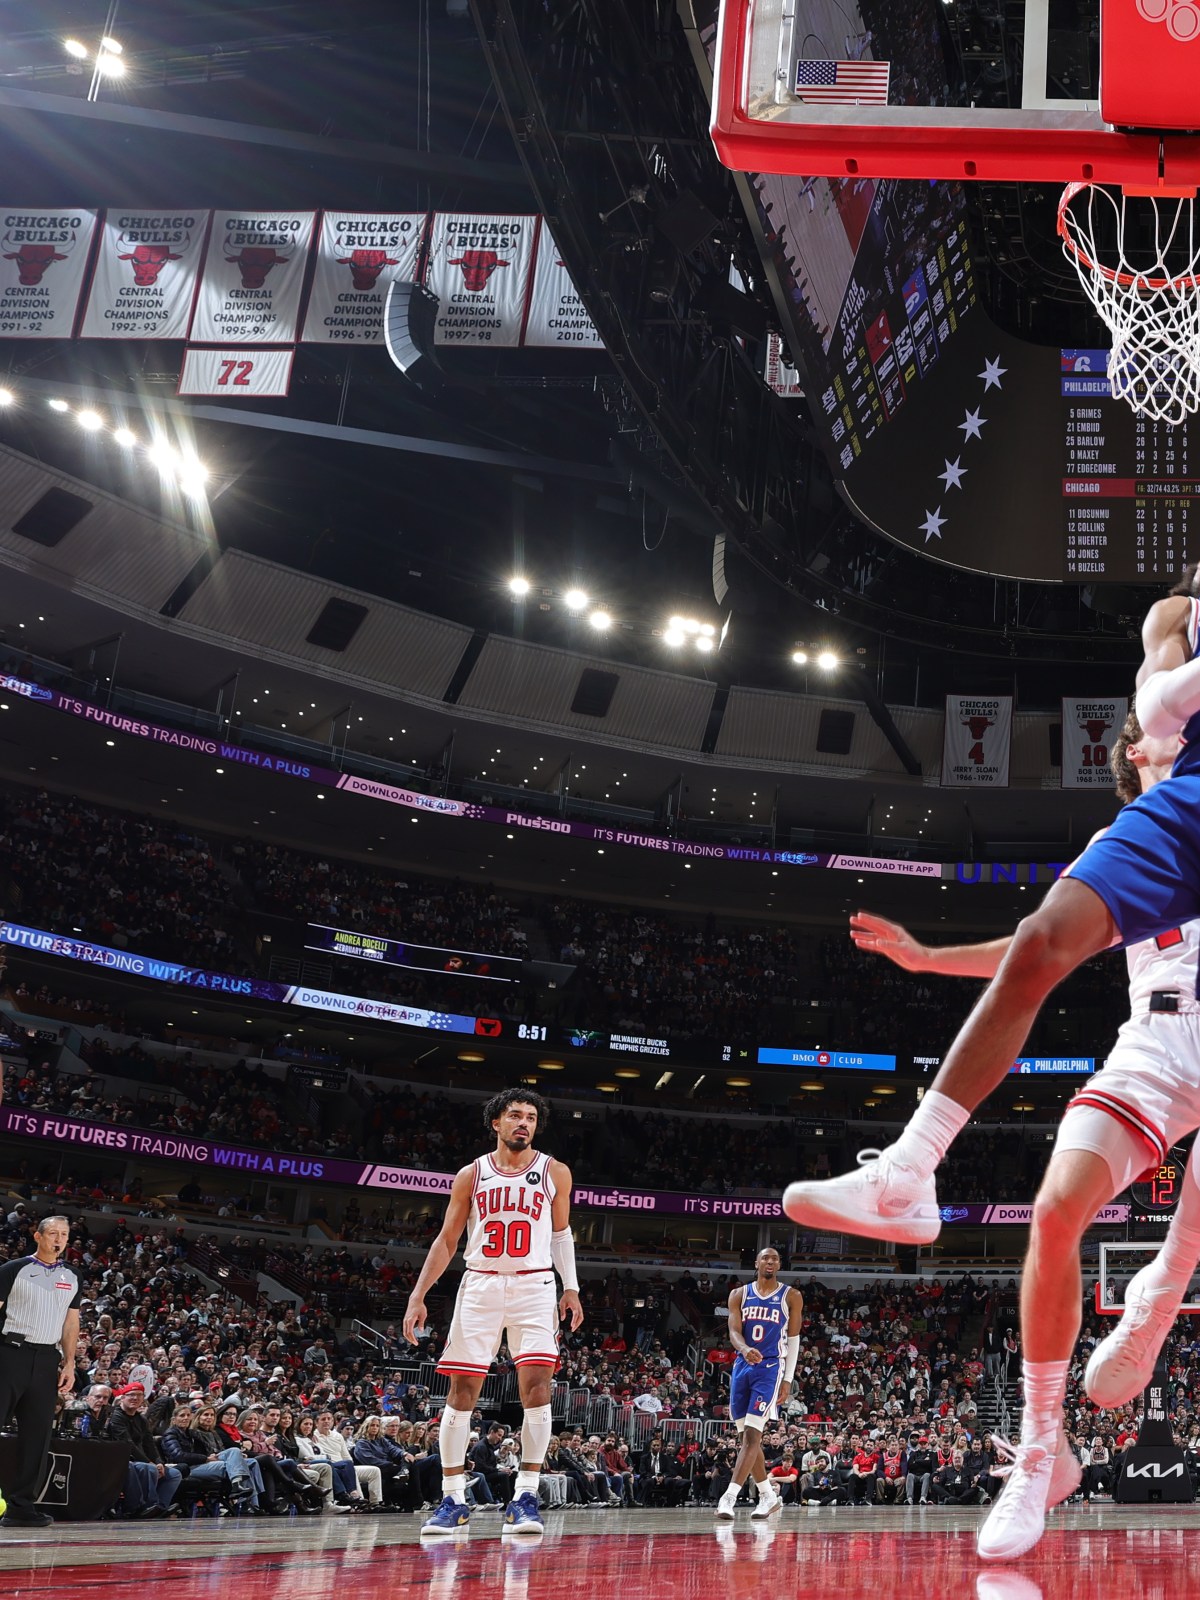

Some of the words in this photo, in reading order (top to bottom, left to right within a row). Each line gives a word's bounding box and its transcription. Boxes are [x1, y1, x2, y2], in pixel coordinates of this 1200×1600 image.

[4, 216, 82, 228] CHICAGO
[118, 216, 194, 229] CHICAGO
[225, 219, 300, 231] CHICAGO
[447, 223, 521, 234] CHICAGO
[13, 230, 68, 242] BULLS
[128, 231, 182, 242] BULLS
[234, 234, 288, 245] BULLS
[456, 236, 510, 248] BULLS
[119, 287, 164, 296] CENTRAL
[115, 299, 163, 308] DIVISION
[452, 294, 495, 303] CENTRAL
[104, 310, 168, 319] CHAMPIONS
[448, 307, 495, 316] DIVISION
[438, 318, 501, 328] CHAMPIONS
[218, 360, 254, 386] 72
[1077, 409, 1101, 418] GRIMES
[1077, 436, 1104, 446] BARLOW
[1077, 450, 1099, 460] MAXEY
[1077, 464, 1116, 474] EDGECOMBE
[1065, 483, 1100, 493] CHICAGO
[1078, 523, 1105, 532] COLLINS
[1078, 536, 1107, 545] HUERTER
[1078, 550, 1099, 559] JONES
[1078, 563, 1105, 572] BUZELIS
[59, 697, 82, 714] IT'S
[86, 707, 149, 735] FUTURES
[152, 727, 217, 754] TRADING
[221, 745, 259, 765] WITH
[263, 758, 272, 768] A
[276, 760, 310, 777] PLUS
[968, 742, 984, 764] 4
[1082, 745, 1107, 766] 10
[353, 781, 413, 803] DOWNLOAD
[507, 813, 571, 833] Plus500
[593, 829, 614, 840] IT'S
[617, 833, 669, 850] FUTURES
[672, 842, 724, 857] TRADING
[727, 849, 759, 860] WITH
[763, 851, 770, 861] A
[840, 859, 895, 870] DOWNLOAD
[916, 865, 933, 874] APP
[335, 932, 360, 946] ANDREA
[362, 938, 387, 951] BOCELLI
[76, 944, 144, 973] TRADING
[149, 963, 192, 983] WITH
[196, 974, 207, 986] A
[211, 976, 252, 993] PLUS
[302, 992, 373, 1014] DOWNLOAD
[518, 1024, 546, 1041] 8:51
[610, 1034, 645, 1045] MILWAUKEE
[610, 1042, 638, 1052] MEMPHIS
[640, 1046, 670, 1056] GRIZZLIES
[793, 1054, 814, 1062] BMO
[839, 1056, 862, 1064] CLUB
[1035, 1060, 1088, 1070] PHILADELPHIA
[7, 1113, 36, 1133] IT'S
[42, 1121, 127, 1148] FUTURES
[131, 1135, 208, 1161] TRADING
[213, 1149, 259, 1169] WITH
[262, 1157, 275, 1170] A
[279, 1159, 323, 1178] PLUS
[1152, 1180, 1172, 1204] 12
[476, 1187, 544, 1221] BULLS
[574, 1190, 655, 1210] Plus500
[684, 1198, 709, 1213] IT'S
[713, 1201, 781, 1216] FUTURES
[482, 1221, 531, 1257] 30
[742, 1306, 780, 1323] PHILA
[752, 1325, 764, 1342] 0
[1150, 1388, 1162, 1397] GET
[1151, 1398, 1162, 1408] THE
[1153, 1410, 1164, 1421] App
